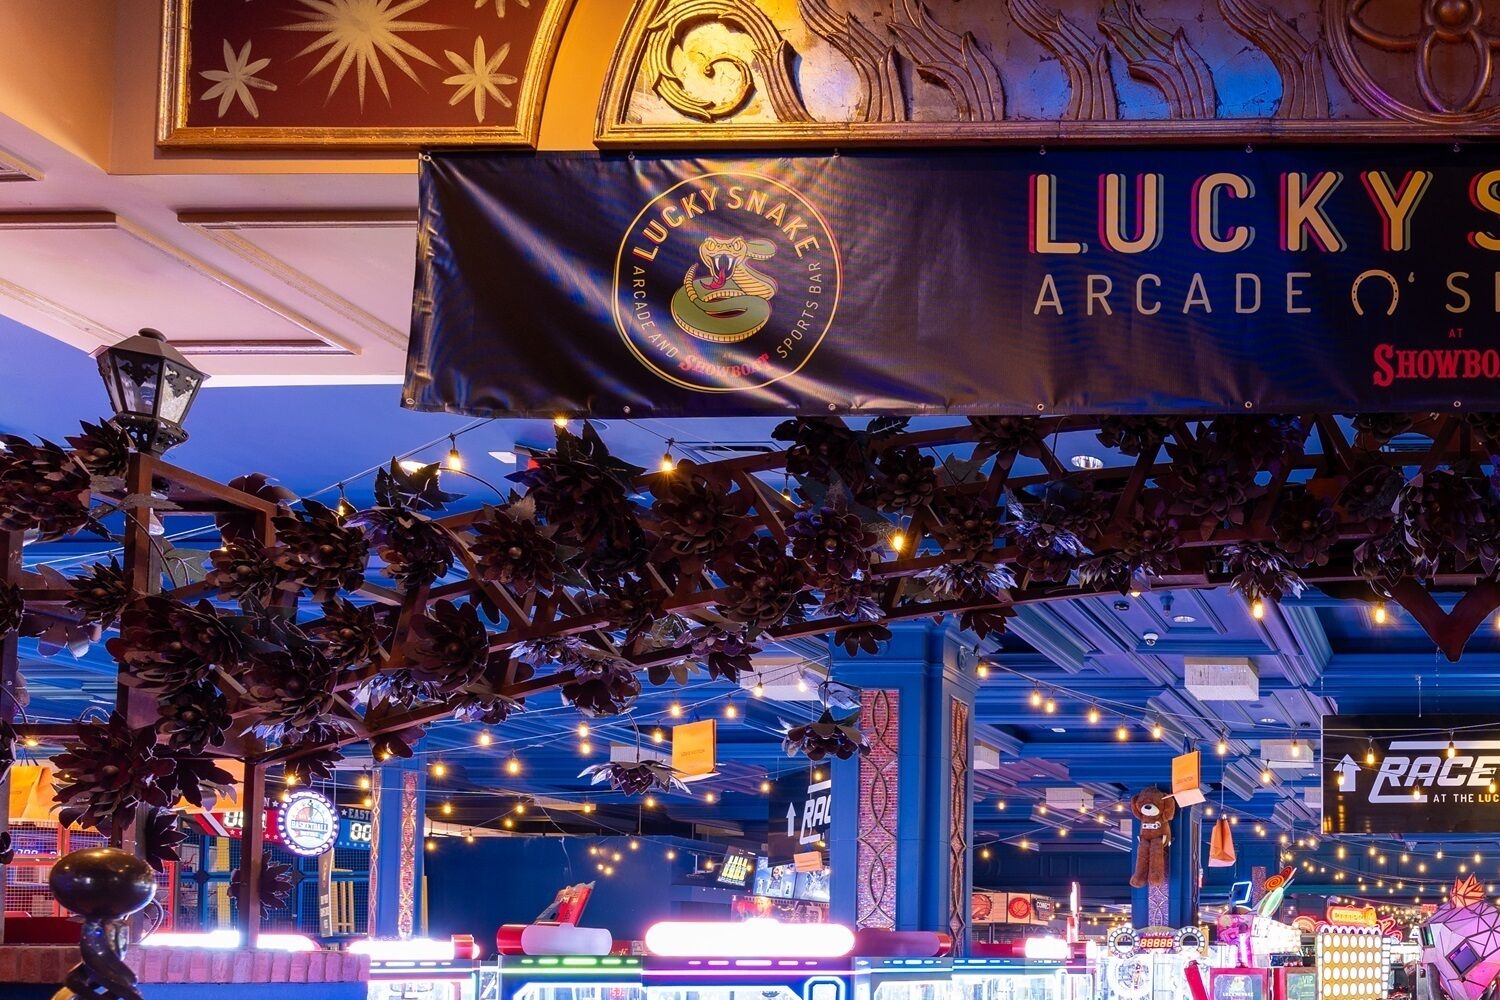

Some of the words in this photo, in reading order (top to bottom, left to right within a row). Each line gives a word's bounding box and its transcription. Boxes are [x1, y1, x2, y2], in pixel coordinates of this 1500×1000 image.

[632, 186, 719, 263] LUCKY
[727, 185, 821, 260] SNAKE
[1030, 171, 1431, 254] LUCKY
[633, 265, 656, 331] ARCADE
[648, 331, 679, 359] AND
[776, 300, 819, 359] SPORTS
[808, 261, 822, 295] BAR
[1034, 272, 1313, 316] ARCADE
[1449, 328, 1464, 338] AT
[1433, 793, 1446, 803] AT
[1453, 793, 1474, 803] THE
